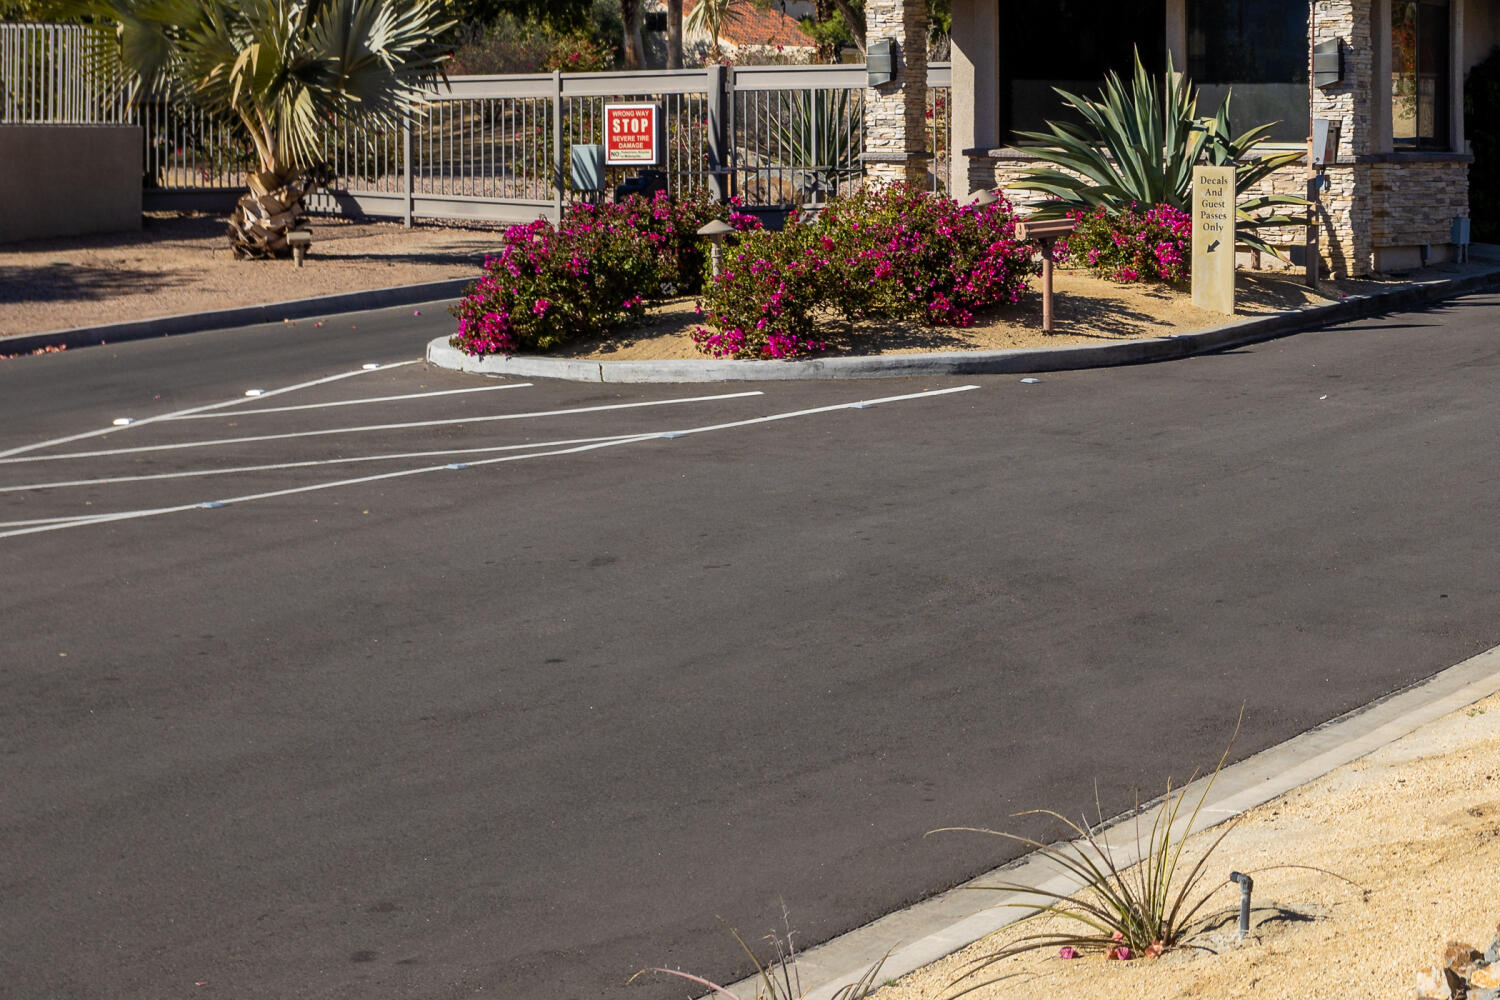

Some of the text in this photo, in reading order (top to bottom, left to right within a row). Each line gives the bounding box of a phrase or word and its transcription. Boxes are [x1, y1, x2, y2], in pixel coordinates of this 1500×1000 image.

[612, 118, 649, 133] STOP
[1200, 176, 1228, 185] Decals
[1205, 188, 1223, 197] And
[1201, 200, 1225, 208] Guest
[1200, 211, 1227, 220] Passes
[1202, 223, 1224, 233] Only
